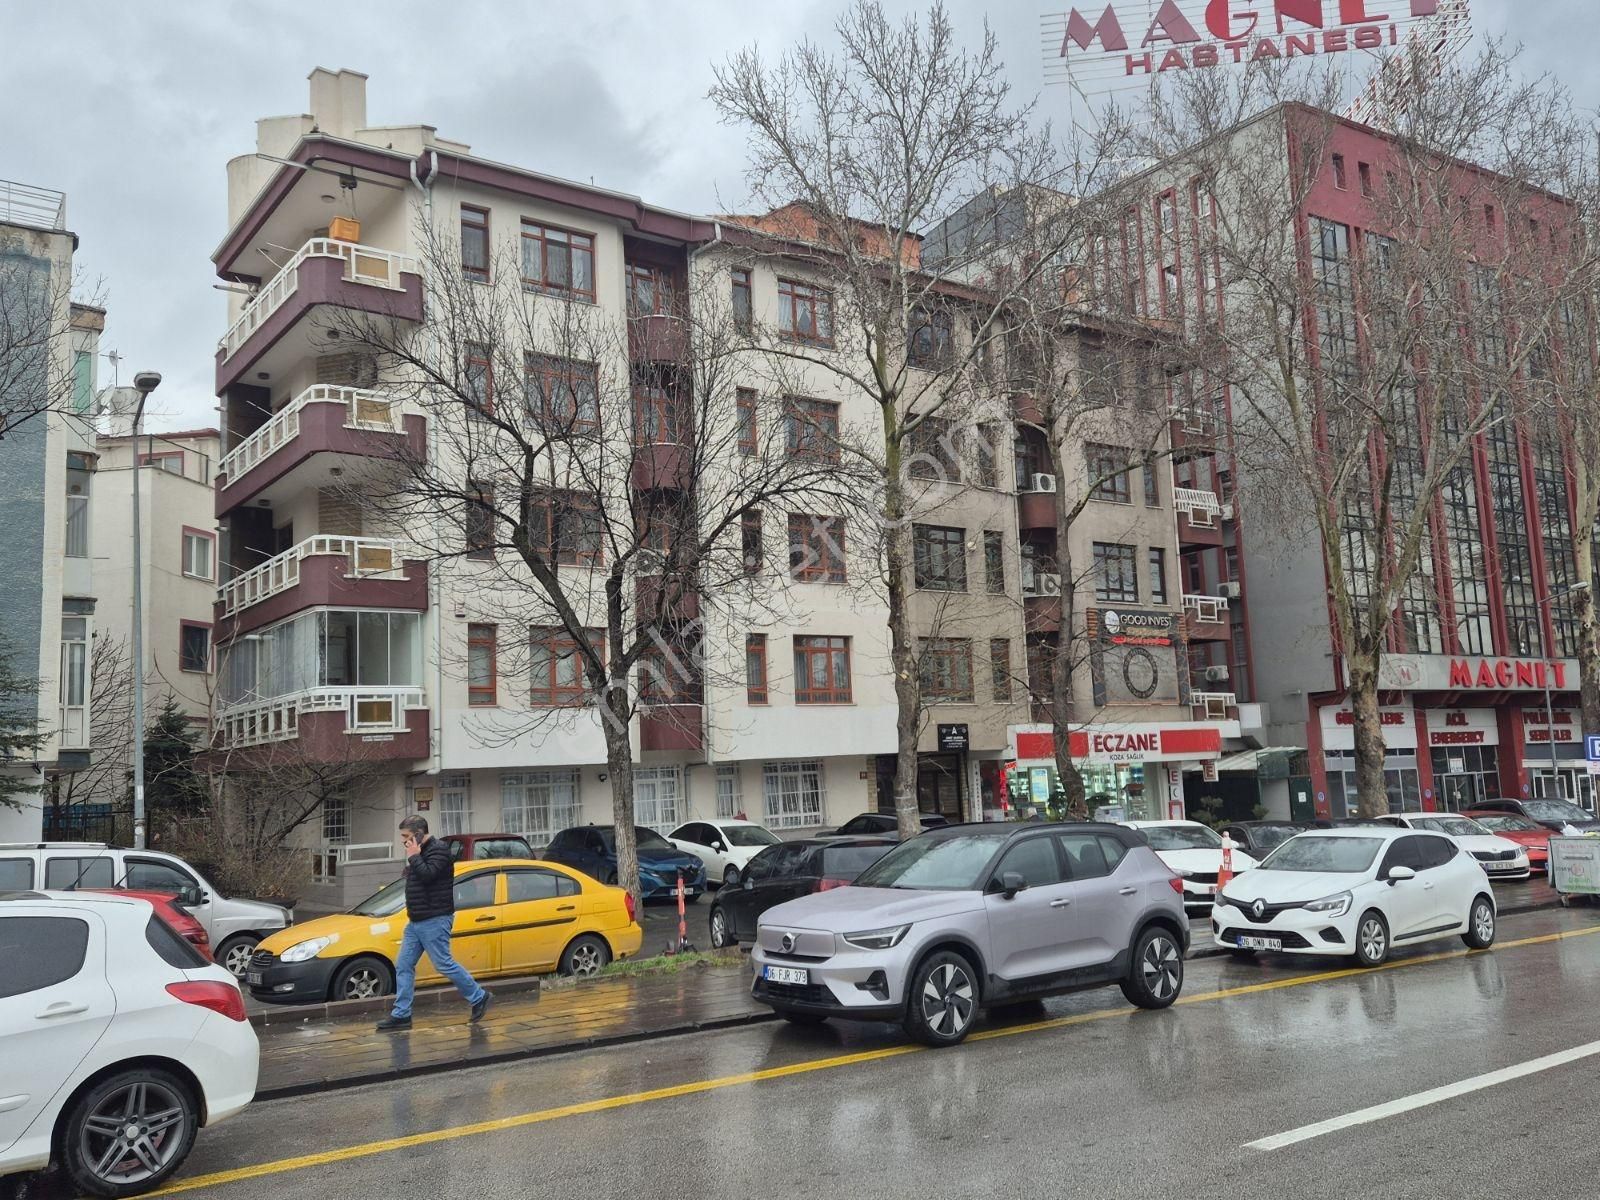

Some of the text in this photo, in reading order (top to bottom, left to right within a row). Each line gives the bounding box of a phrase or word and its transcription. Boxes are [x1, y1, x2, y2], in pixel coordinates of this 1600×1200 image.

[1125, 24, 1397, 76] HASTANESİ
[1120, 614, 1147, 625] GOOD
[1093, 733, 1158, 753] ECZANE
[1430, 731, 1485, 745] EMERGENCY
[768, 968, 775, 978] 06
[794, 971, 807, 982] 379
